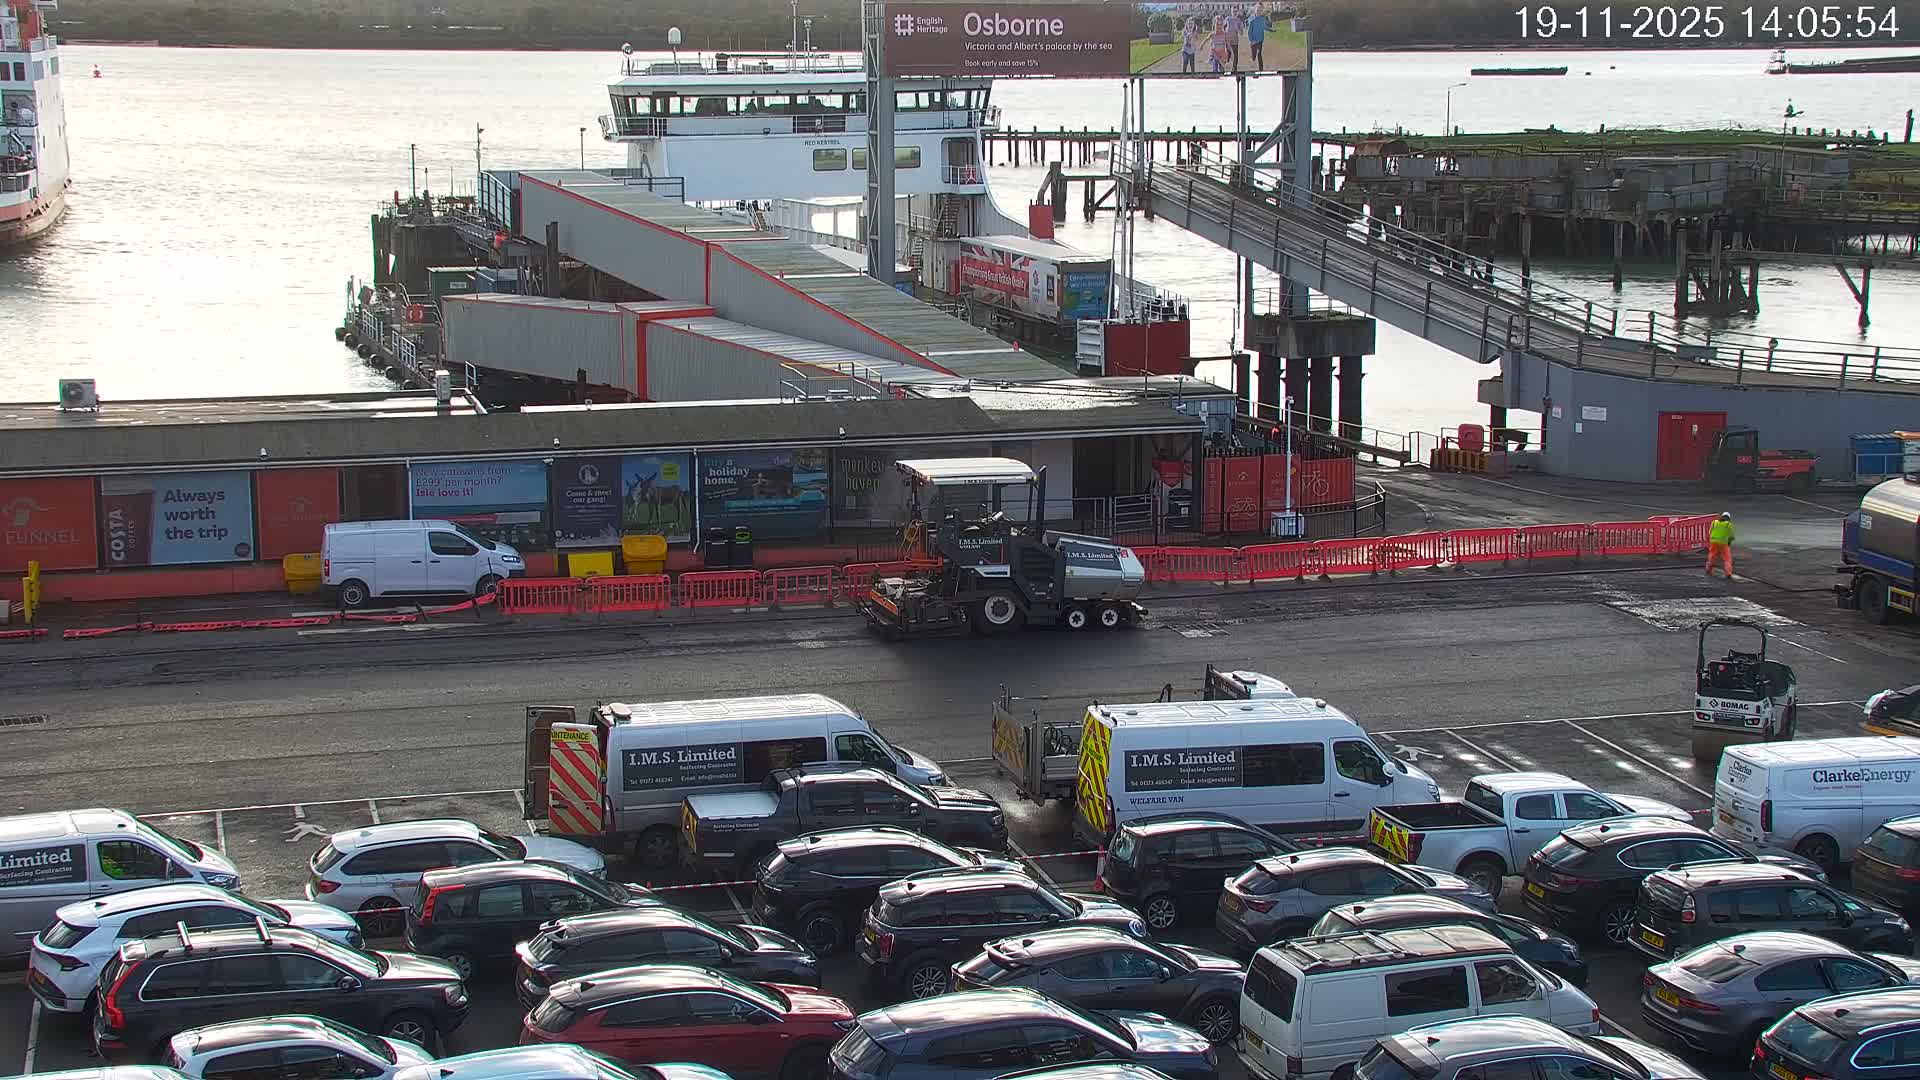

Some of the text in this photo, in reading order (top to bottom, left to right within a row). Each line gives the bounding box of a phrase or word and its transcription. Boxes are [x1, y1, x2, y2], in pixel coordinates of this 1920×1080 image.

[917, 17, 943, 26] English
[963, 12, 1064, 36] Osborne
[917, 25, 948, 34] Heritage
[964, 42, 995, 51] Victoria
[997, 42, 1013, 51] and
[1045, 42, 1071, 52] palace
[1073, 42, 1083, 52] by
[1083, 42, 1098, 50] the
[981, 60, 997, 68] early
[963, 264, 987, 281] Championing
[988, 270, 998, 282] Great
[1012, 276, 1026, 289] Quality
[709, 467, 750, 477] holiday
[445, 478, 461, 487] per
[464, 475, 502, 486] month?
[704, 477, 736, 486] home.
[164, 489, 225, 504] Always
[415, 488, 435, 497] Isle
[438, 487, 460, 496] love
[164, 507, 216, 521] worth
[6, 529, 80, 544] FUNNEL
[109, 506, 125, 561] COSTA
[164, 524, 228, 540] the trip
[1720, 701, 1749, 711] BOMAG
[629, 747, 736, 766] I.M.S. Limited
[1130, 750, 1235, 767] I.M.S. Limited
[1812, 767, 1912, 785] ClarkeEnergy
[1129, 797, 1167, 805] WELFARE
[0, 848, 72, 870] Limited
